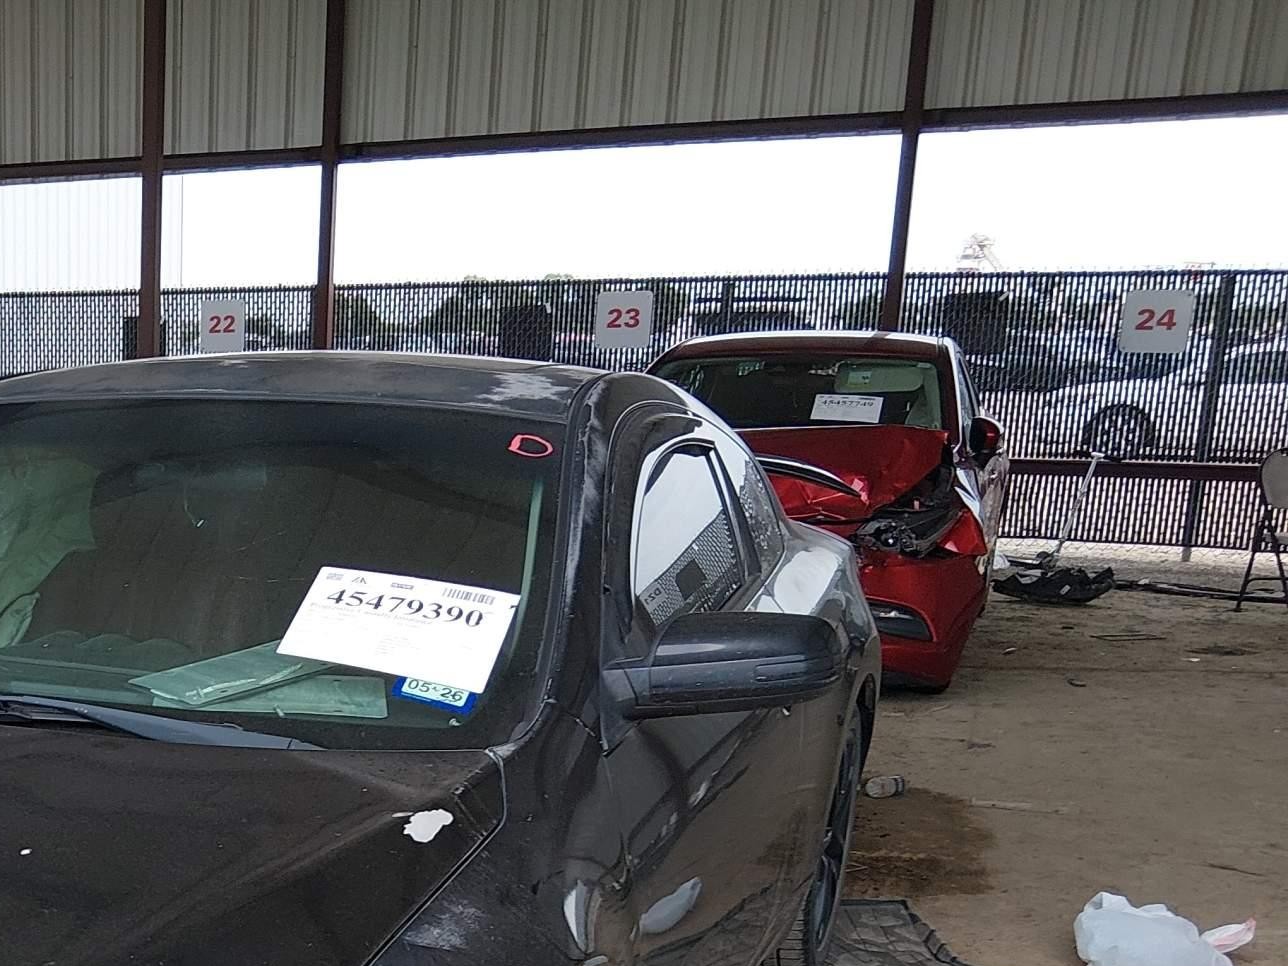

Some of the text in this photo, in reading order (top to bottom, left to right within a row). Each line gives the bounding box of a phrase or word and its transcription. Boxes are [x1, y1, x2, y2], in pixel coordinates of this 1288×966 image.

[208, 315, 236, 334] 22
[606, 307, 641, 329] 23
[1135, 308, 1177, 331] 24
[326, 588, 483, 628] 45479390
